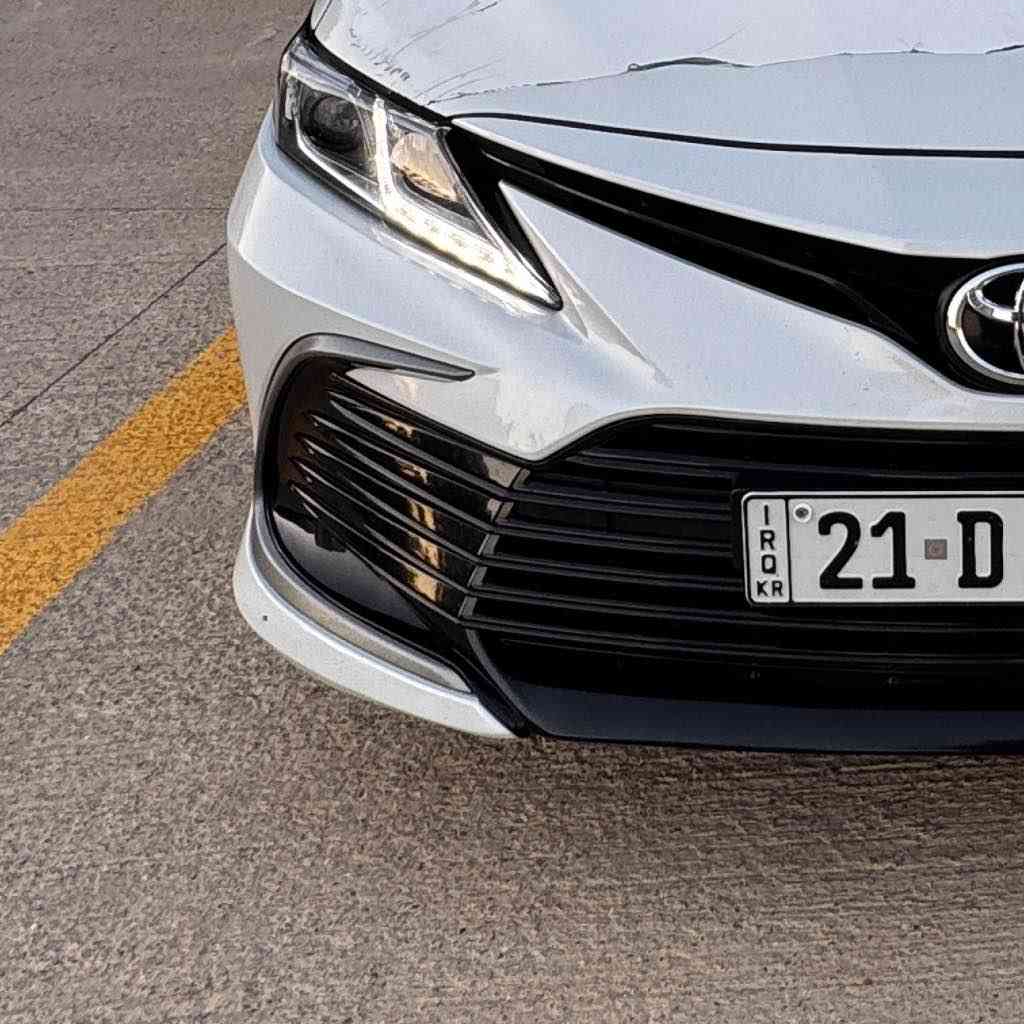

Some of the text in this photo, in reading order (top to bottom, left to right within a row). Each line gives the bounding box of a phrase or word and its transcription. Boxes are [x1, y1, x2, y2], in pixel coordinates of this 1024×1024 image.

[816, 510, 916, 590] 21
[956, 510, 1005, 590] D
[756, 580, 783, 597] KR
